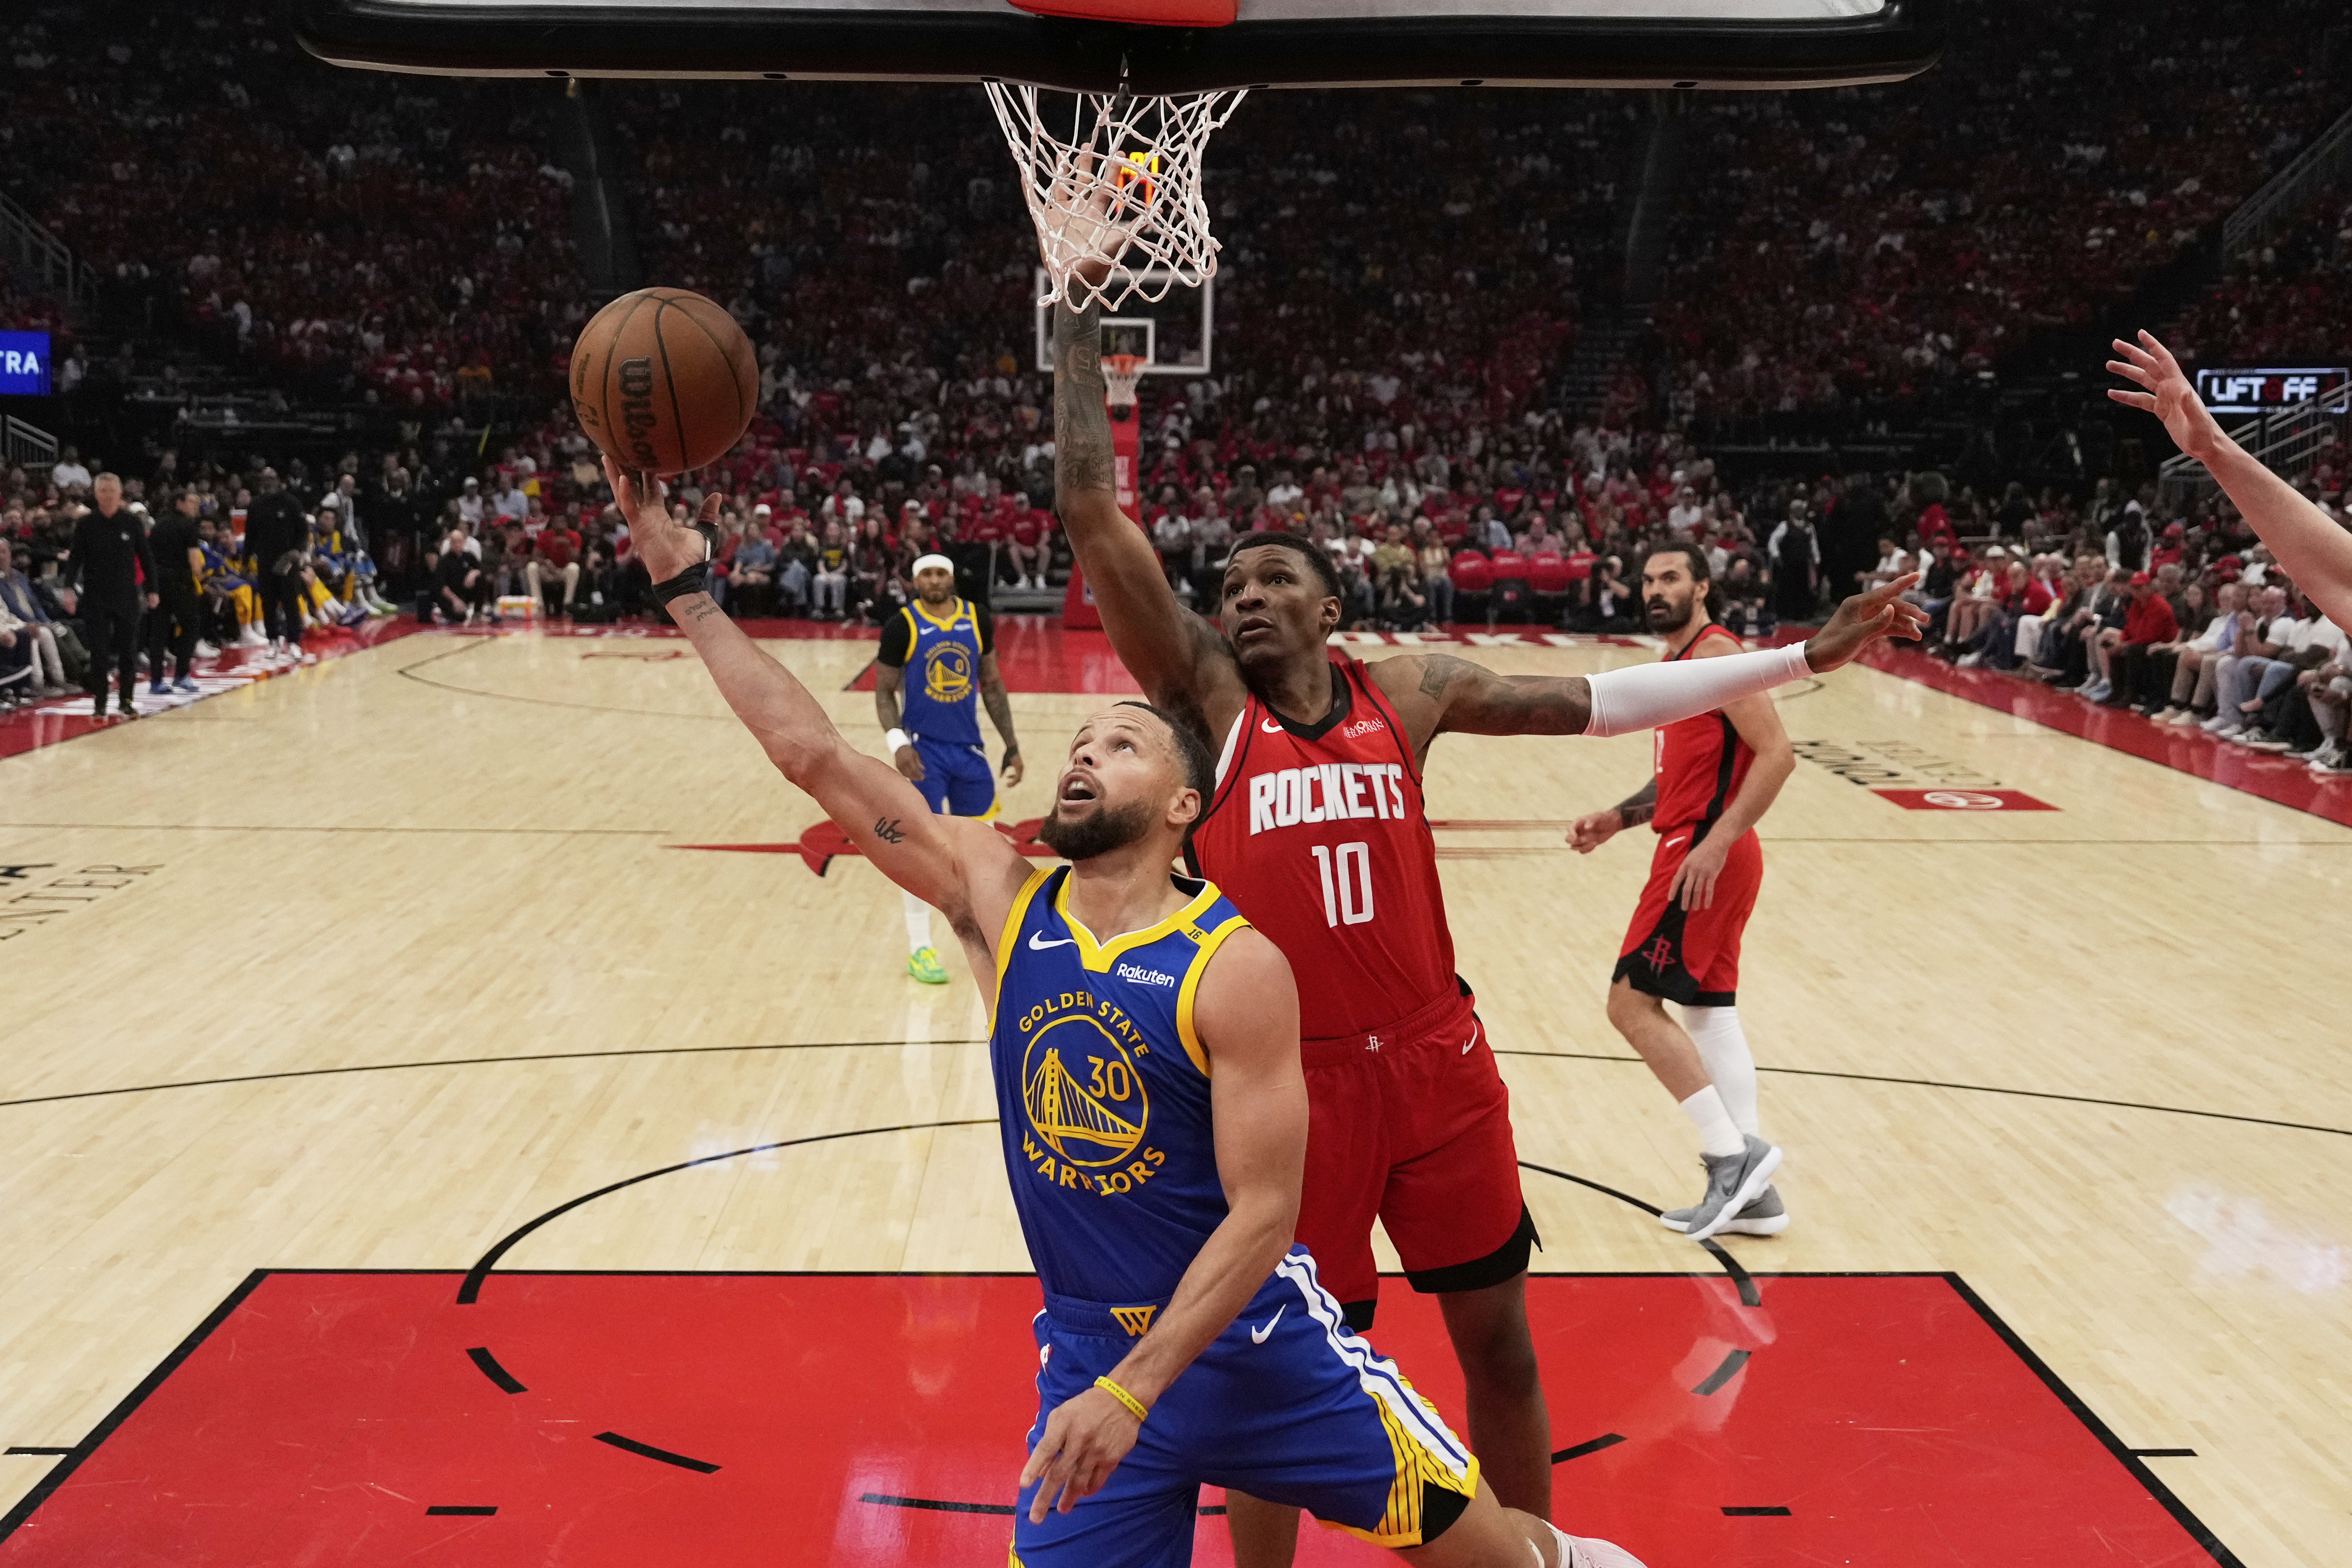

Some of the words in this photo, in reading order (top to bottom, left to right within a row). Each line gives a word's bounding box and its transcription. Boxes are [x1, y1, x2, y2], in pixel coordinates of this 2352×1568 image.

[0, 350, 39, 375] RA
[955, 658, 964, 673] 0
[1249, 763, 1405, 836] ROCKETS
[0, 863, 165, 941] NTER
[1311, 842, 1375, 929] 10
[1187, 929, 1202, 940] 16
[1116, 963, 1175, 987] Rakuten
[1019, 991, 1094, 1033] GOLDEN
[1098, 1001, 1151, 1059] STATE
[1087, 1054, 1130, 1101] 30
[1021, 1129, 1166, 1197] WARRIORS
